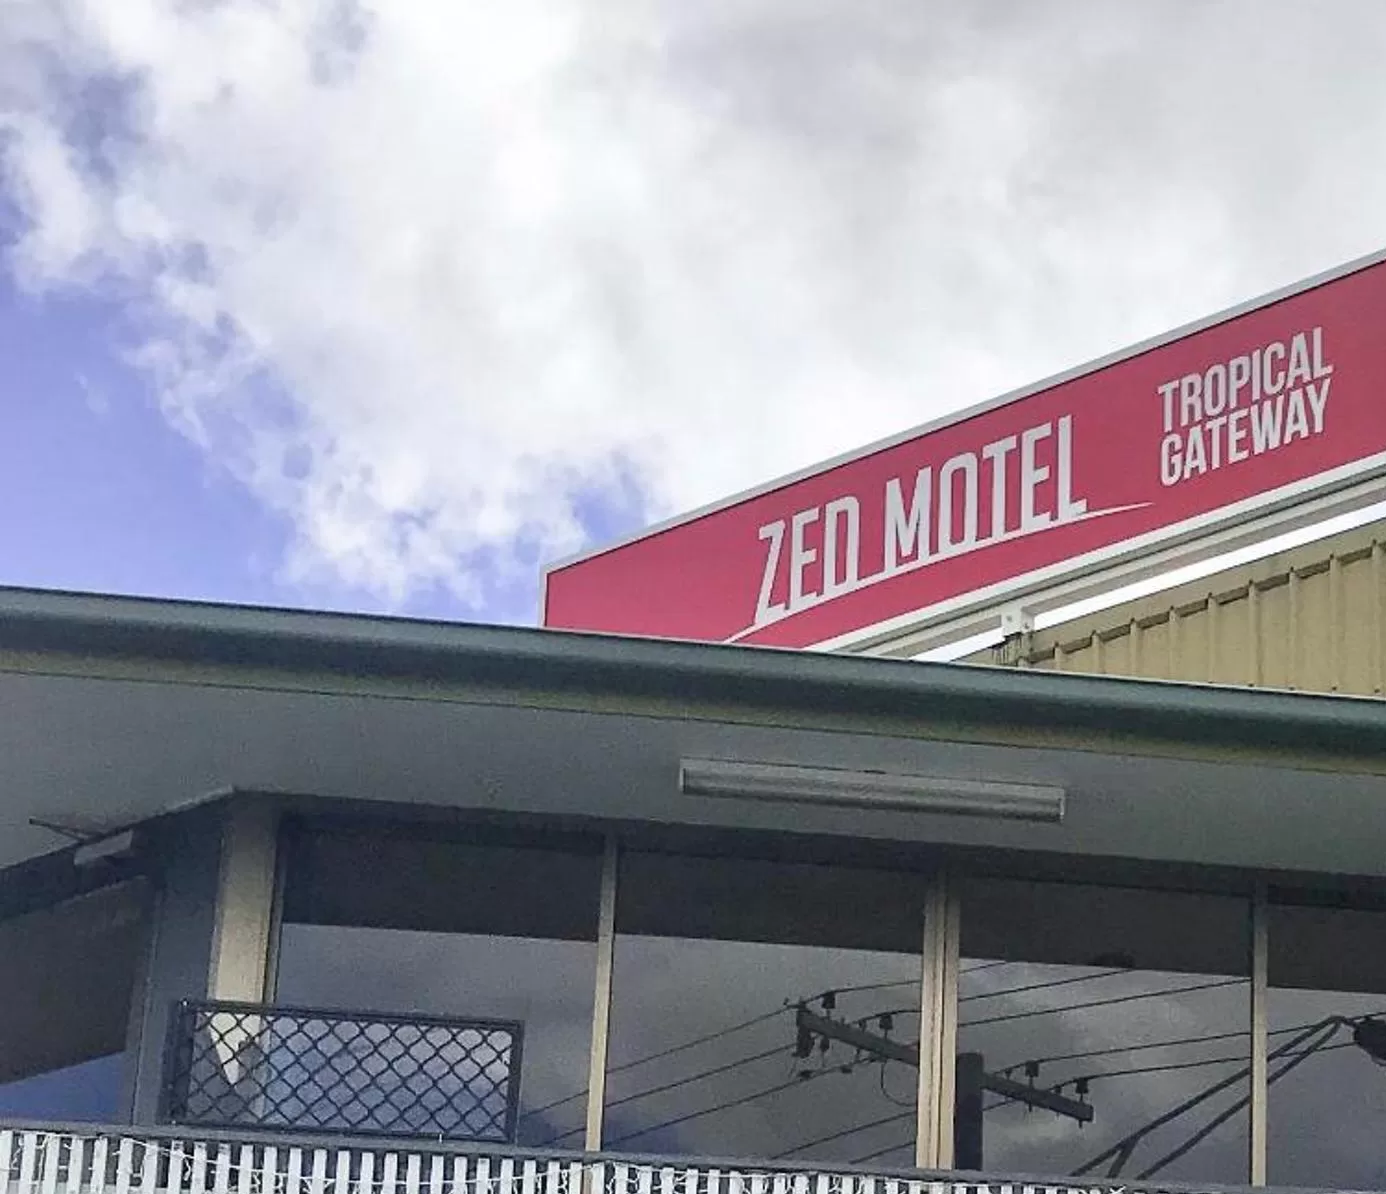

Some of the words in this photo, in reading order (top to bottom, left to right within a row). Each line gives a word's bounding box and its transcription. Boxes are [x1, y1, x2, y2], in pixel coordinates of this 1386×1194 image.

[1158, 327, 1333, 432] TROPICAL
[1161, 378, 1332, 486] GATEWAY
[755, 496, 861, 626] ZED
[884, 415, 1087, 576] MOTEL
